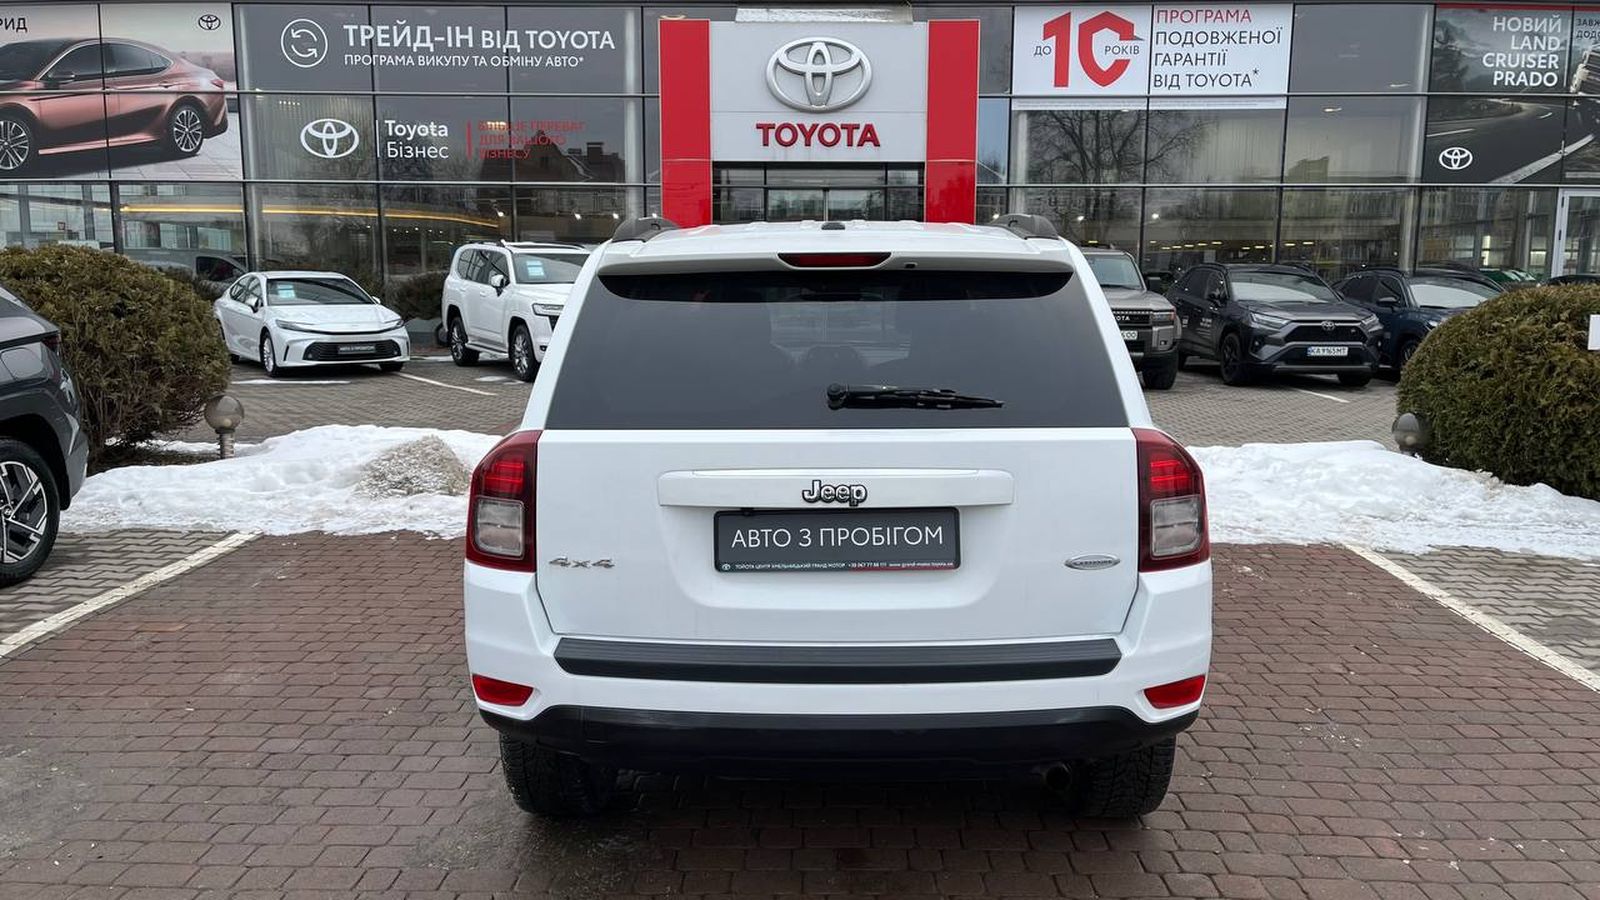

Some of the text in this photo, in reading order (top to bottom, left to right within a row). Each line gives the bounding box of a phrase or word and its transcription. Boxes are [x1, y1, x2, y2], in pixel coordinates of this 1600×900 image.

[1156, 9, 1252, 24] ПРОГРАМА
[1492, 14, 1561, 33] НОВИЙ
[343, 19, 616, 53] ТРЕЙД-ІН ВІД TOYOTA
[1155, 27, 1284, 46] ПОДОВЖЕНОЇ
[1511, 35, 1561, 51] LAND
[1033, 45, 1052, 56] ДО
[1104, 45, 1140, 55] РОКІВ
[1154, 49, 1228, 67] ГАРАНТІЇ
[344, 54, 415, 66] ПРОГРАМА
[418, 55, 470, 67] ВИКУПУ
[472, 55, 488, 67] ТА
[490, 55, 543, 68] ОБМІНУ
[1482, 52, 1559, 69] CRUISER
[1153, 74, 1181, 90] ВІД
[1493, 70, 1558, 87] PRADO
[384, 120, 449, 141] Toyota
[756, 123, 881, 147] TOYOTA
[387, 141, 449, 159] Бізнес
[802, 480, 867, 507] Jeep
[731, 526, 944, 549] АВТО З ПРОБІГОМ
